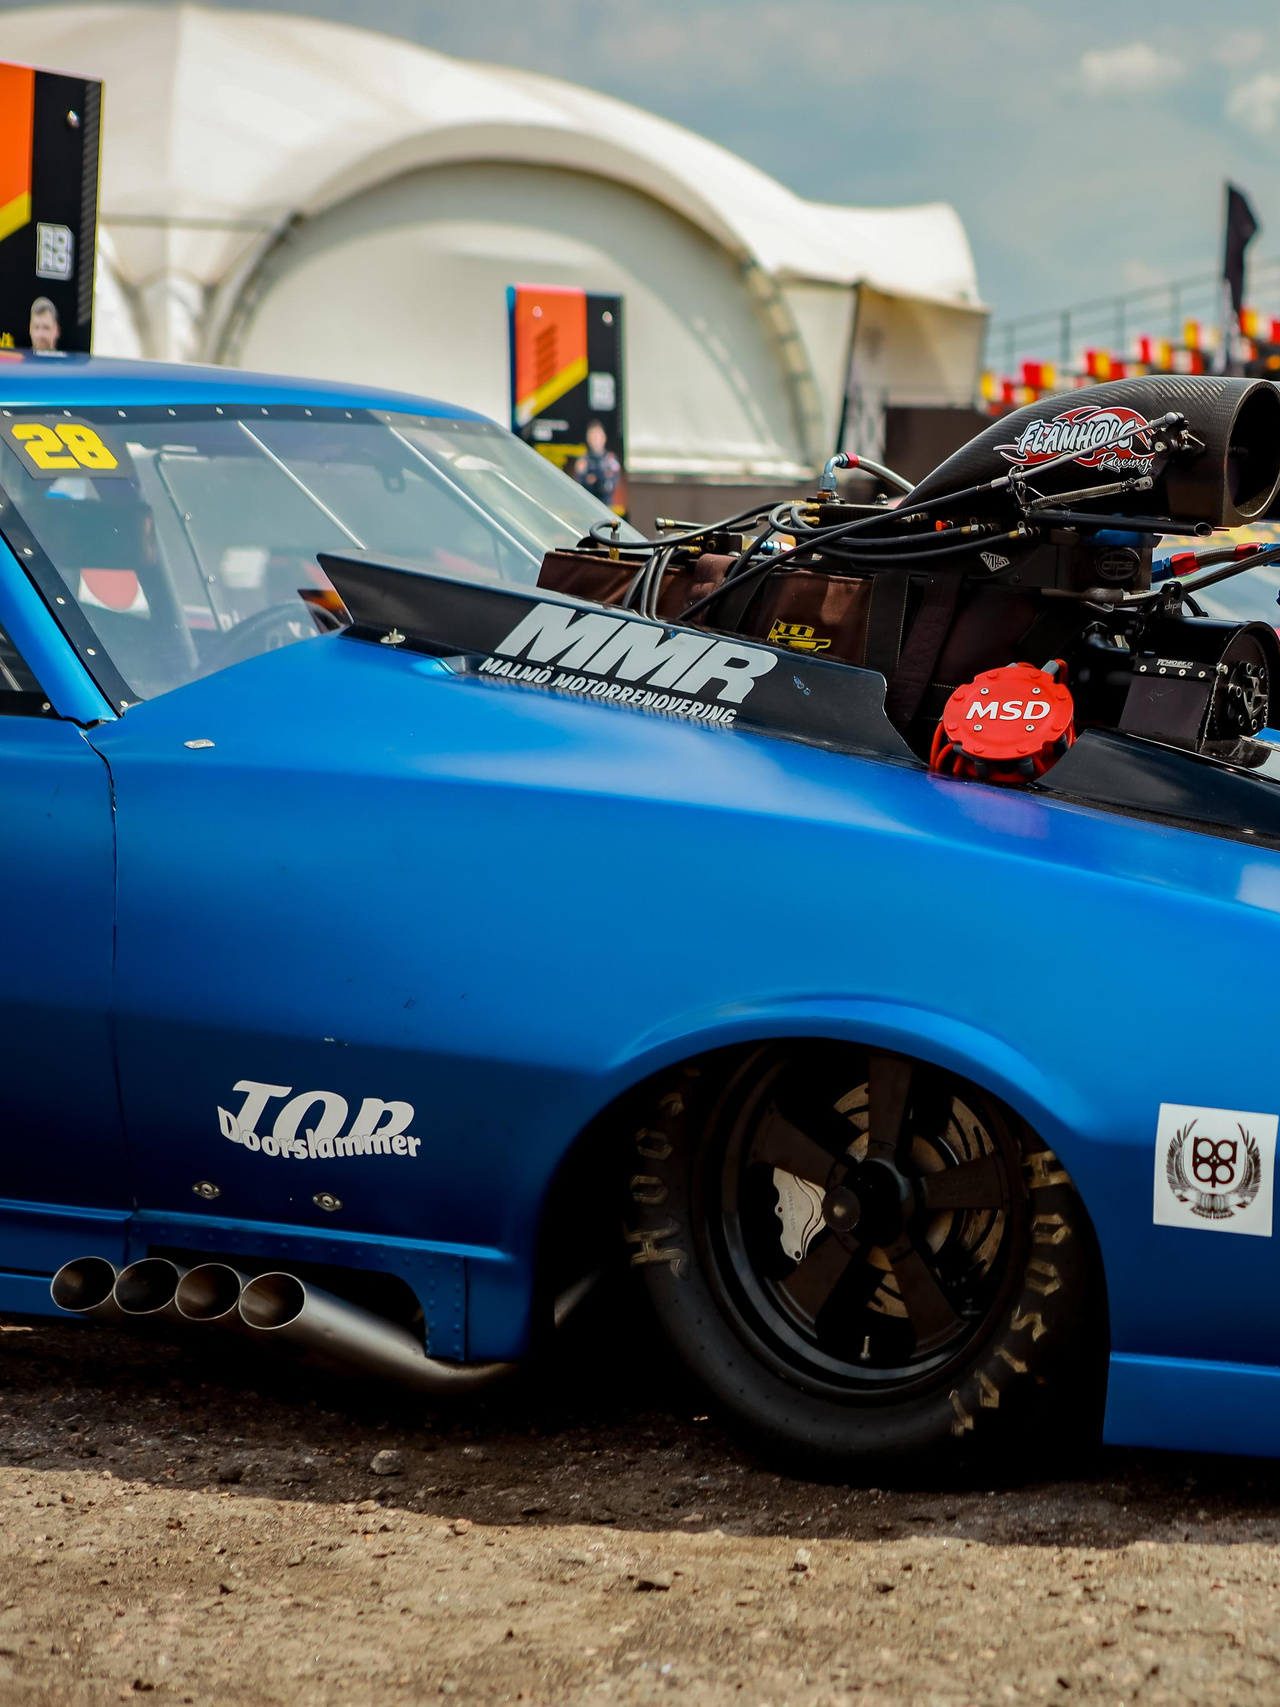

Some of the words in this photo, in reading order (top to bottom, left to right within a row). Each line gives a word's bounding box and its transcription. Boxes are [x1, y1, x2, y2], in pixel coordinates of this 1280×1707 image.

[11, 423, 119, 470] 28
[494, 602, 779, 704] MMR
[478, 657, 554, 683] MALMÖ
[550, 672, 738, 724] MOTORRENOVERING
[965, 700, 1051, 721] MSD
[217, 1105, 422, 1160] Doorslammer
[231, 1079, 415, 1143] TOP
